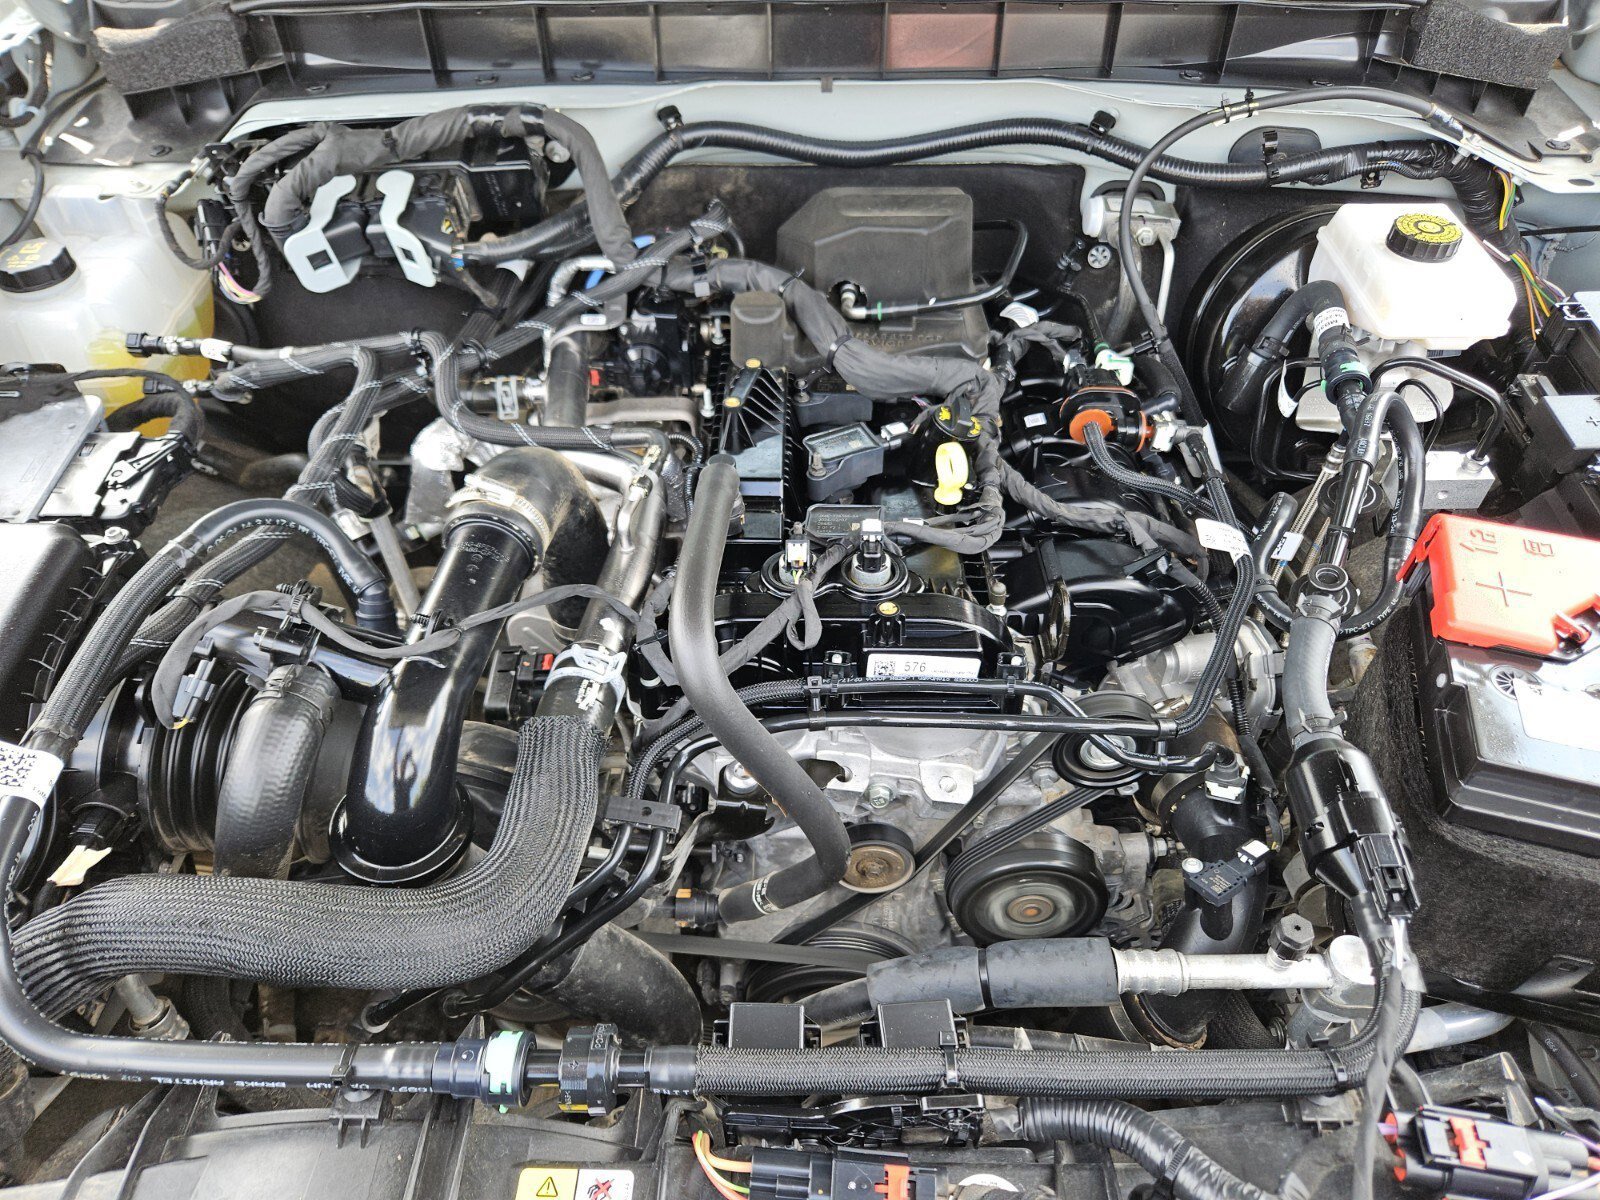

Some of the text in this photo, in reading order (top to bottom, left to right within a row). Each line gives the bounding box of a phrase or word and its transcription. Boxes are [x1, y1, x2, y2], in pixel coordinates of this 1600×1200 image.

[1377, 607, 1392, 622] TYPE
[903, 661, 927, 673] 576
[150, 1075, 225, 1086] ARNITEL
[233, 1080, 287, 1088] BRAKE
